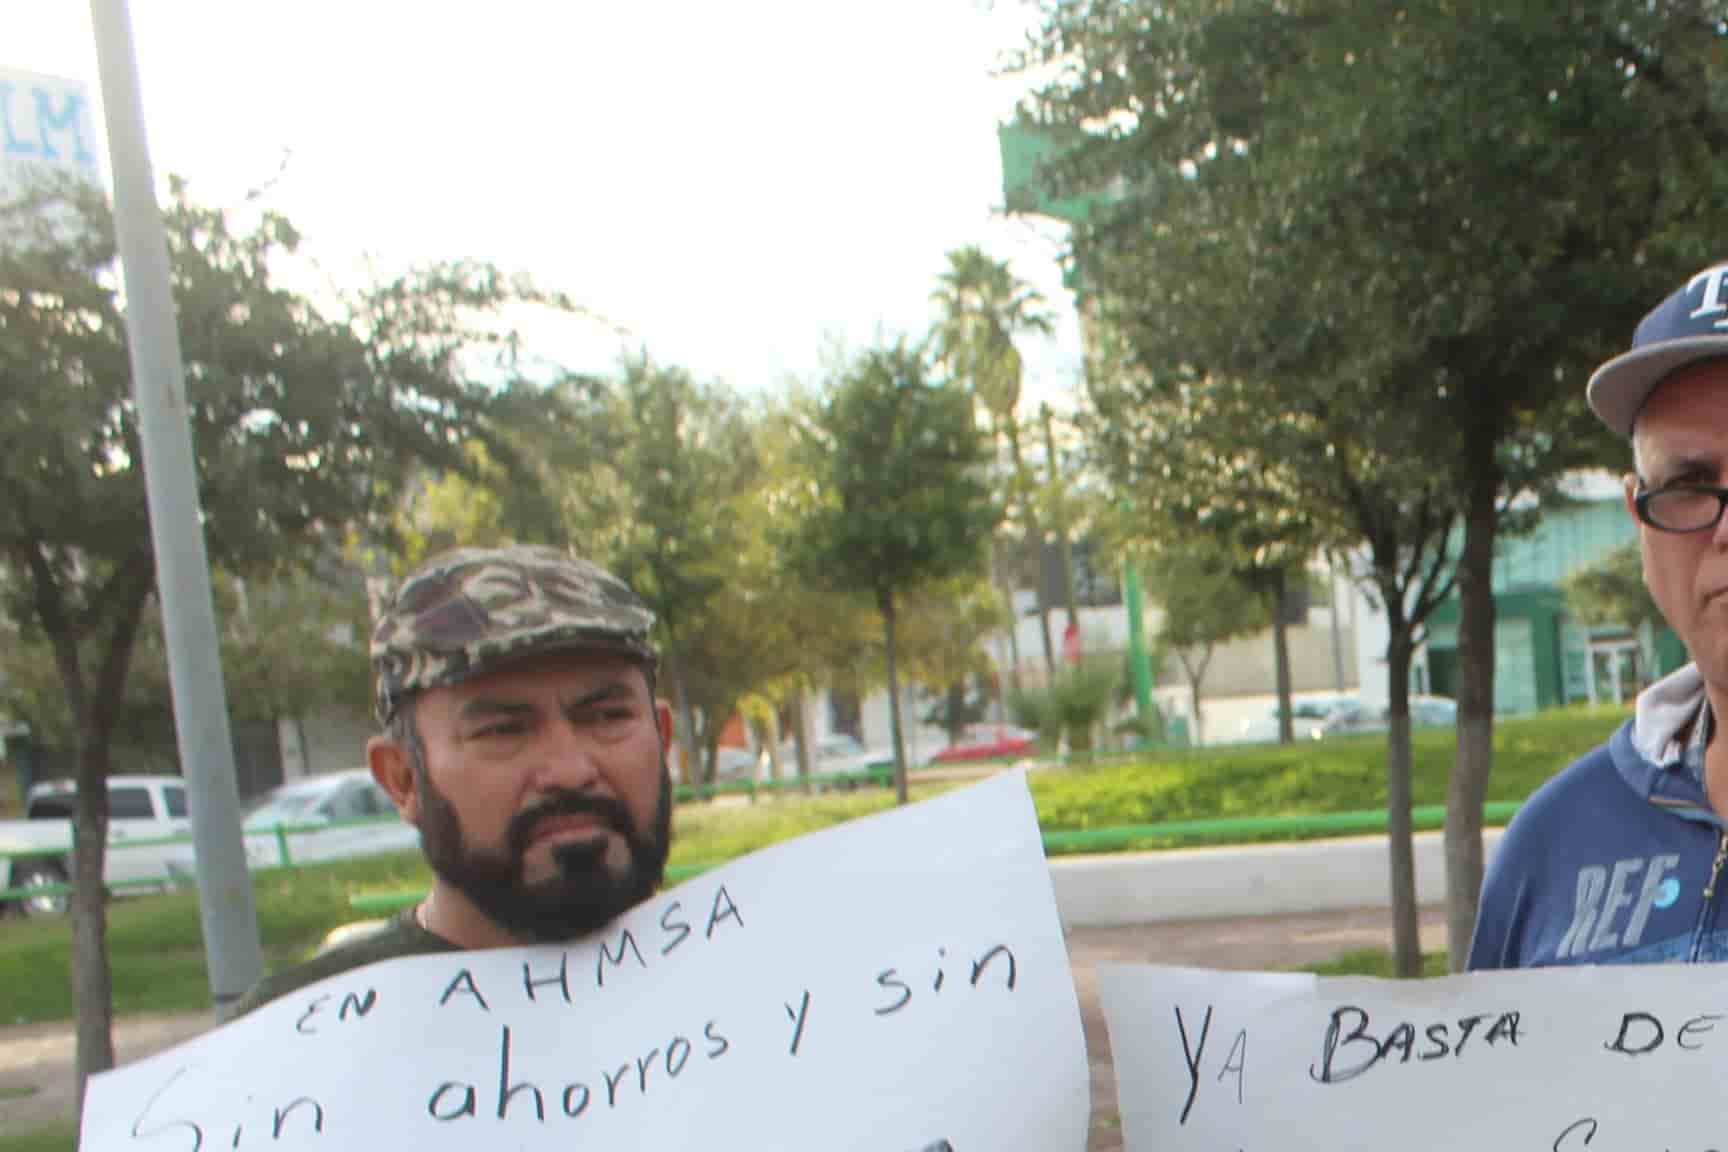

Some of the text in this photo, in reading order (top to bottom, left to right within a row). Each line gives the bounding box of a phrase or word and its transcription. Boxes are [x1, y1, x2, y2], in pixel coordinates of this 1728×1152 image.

[439, 884, 745, 1011] AHMSA
[428, 1020, 729, 1122] ahorros
[874, 944, 1016, 1015] sin
[1175, 1004, 1247, 1125] YA
[1310, 1005, 1525, 1085] BASTA
[1604, 1011, 1726, 1056] DE
